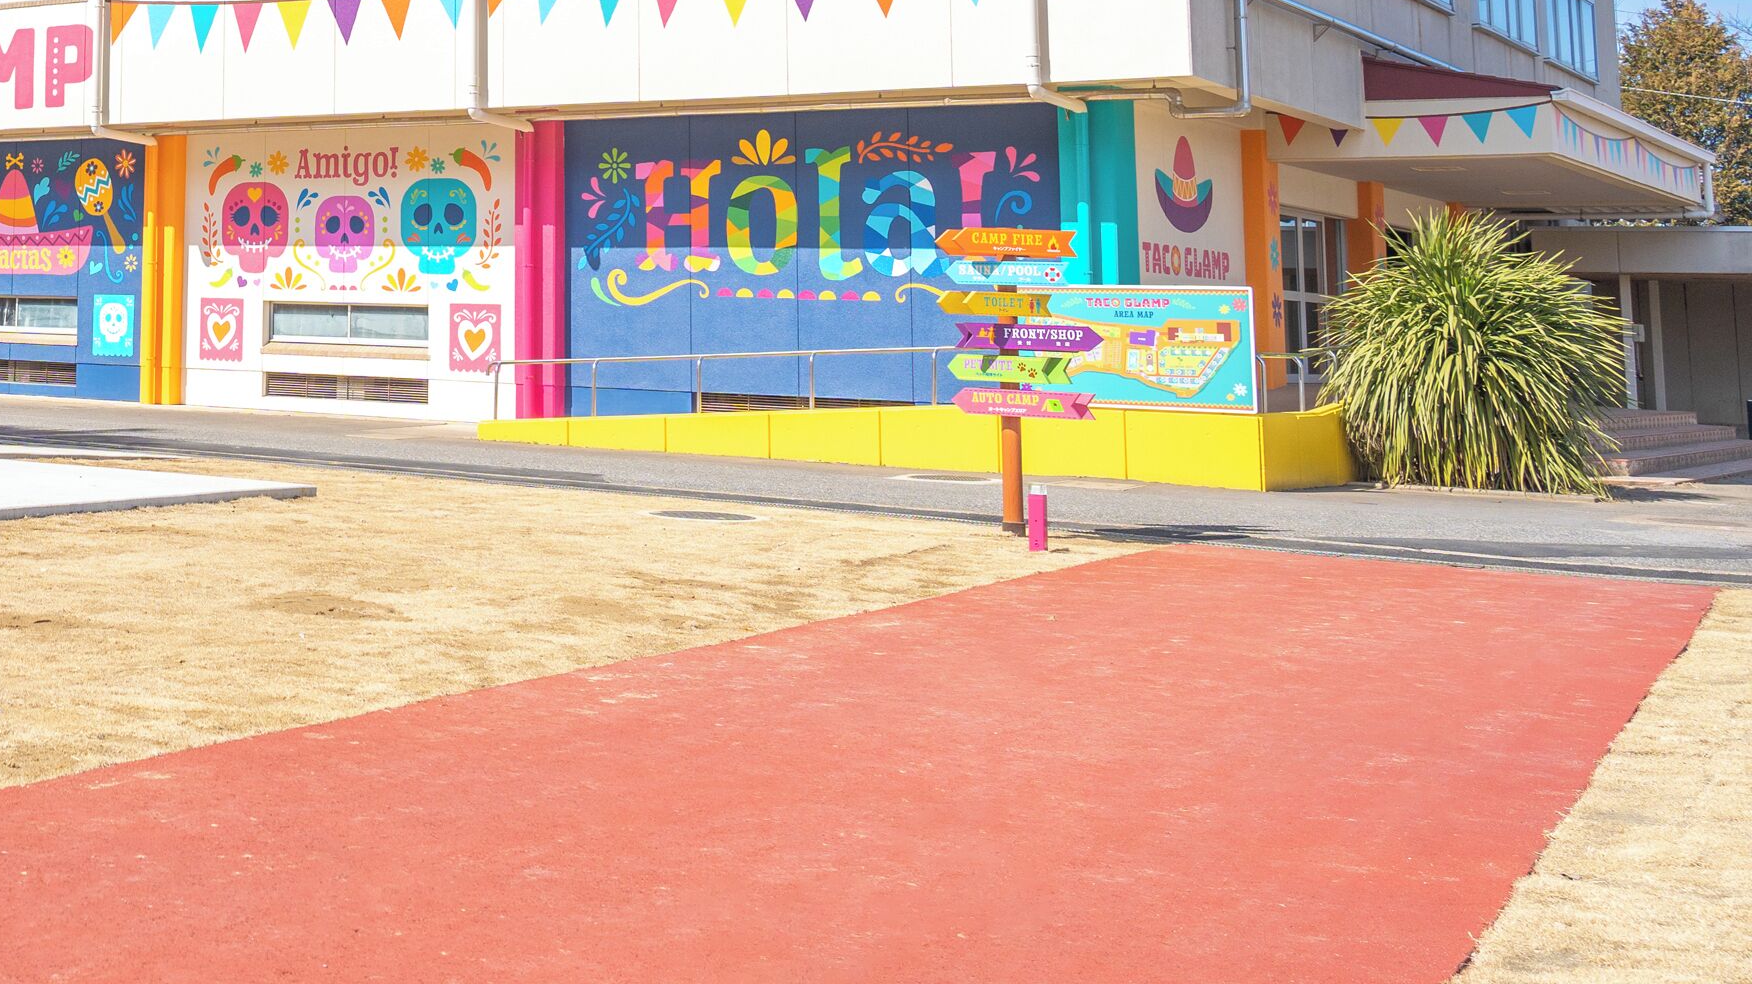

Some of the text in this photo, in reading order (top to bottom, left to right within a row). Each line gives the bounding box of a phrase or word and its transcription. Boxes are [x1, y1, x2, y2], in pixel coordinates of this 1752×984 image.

[294, 145, 399, 187] Amigo!
[971, 231, 1043, 247] CAMP FIRE
[1142, 241, 1230, 280] TACO GLAMP
[958, 264, 1042, 278] SAUNA/POOL
[983, 296, 1024, 309] TOILET
[1085, 297, 1170, 308] TACO GLAMP
[1114, 310, 1154, 319] AREA MAP
[1003, 327, 1084, 342] FRONT/SHOP
[964, 358, 1013, 371] PET SITE
[972, 391, 1040, 406] AUTO CAMP
